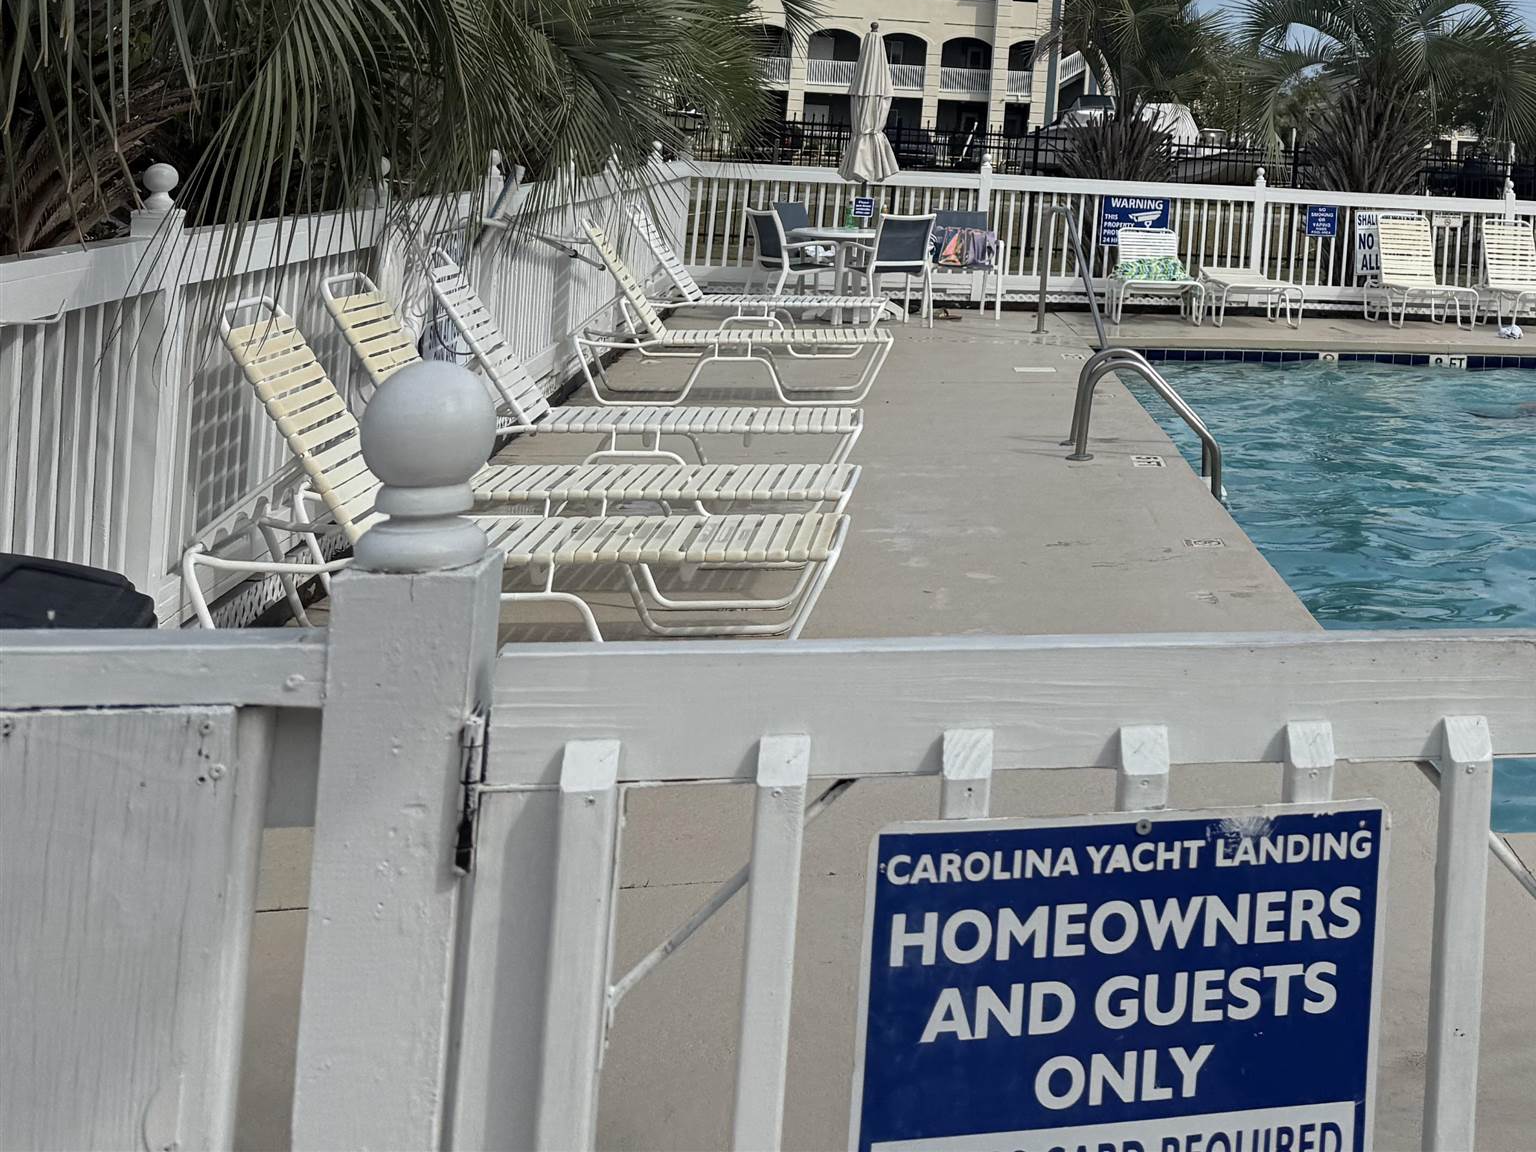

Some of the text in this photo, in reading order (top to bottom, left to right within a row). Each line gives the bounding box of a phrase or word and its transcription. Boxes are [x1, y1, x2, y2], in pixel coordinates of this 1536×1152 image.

[1111, 197, 1164, 210] WARNING
[1358, 233, 1375, 250] NO
[887, 829, 1373, 885] CAROLINA YACHT LANDING
[889, 886, 1362, 967] HOMEOWNERS
[920, 961, 1338, 1043] AND GUESTS
[1035, 1043, 1215, 1110] ONLY
